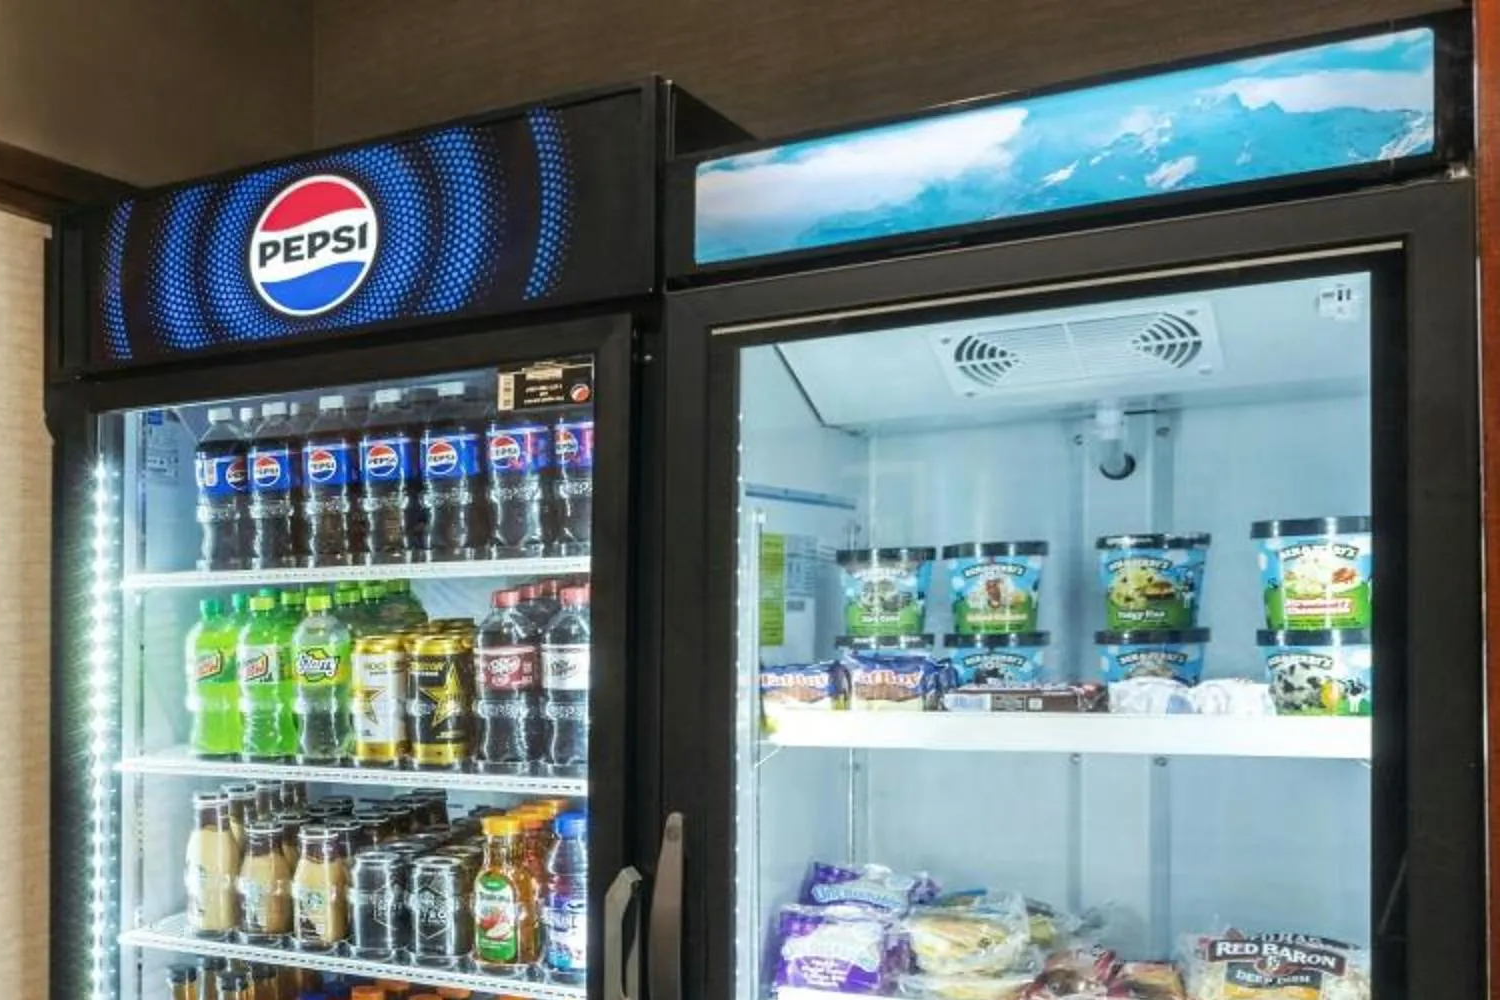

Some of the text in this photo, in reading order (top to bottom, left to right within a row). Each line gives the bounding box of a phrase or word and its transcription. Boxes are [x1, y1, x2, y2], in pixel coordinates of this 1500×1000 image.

[258, 222, 368, 270] PEPSI
[1216, 941, 1337, 968] RED BARON
